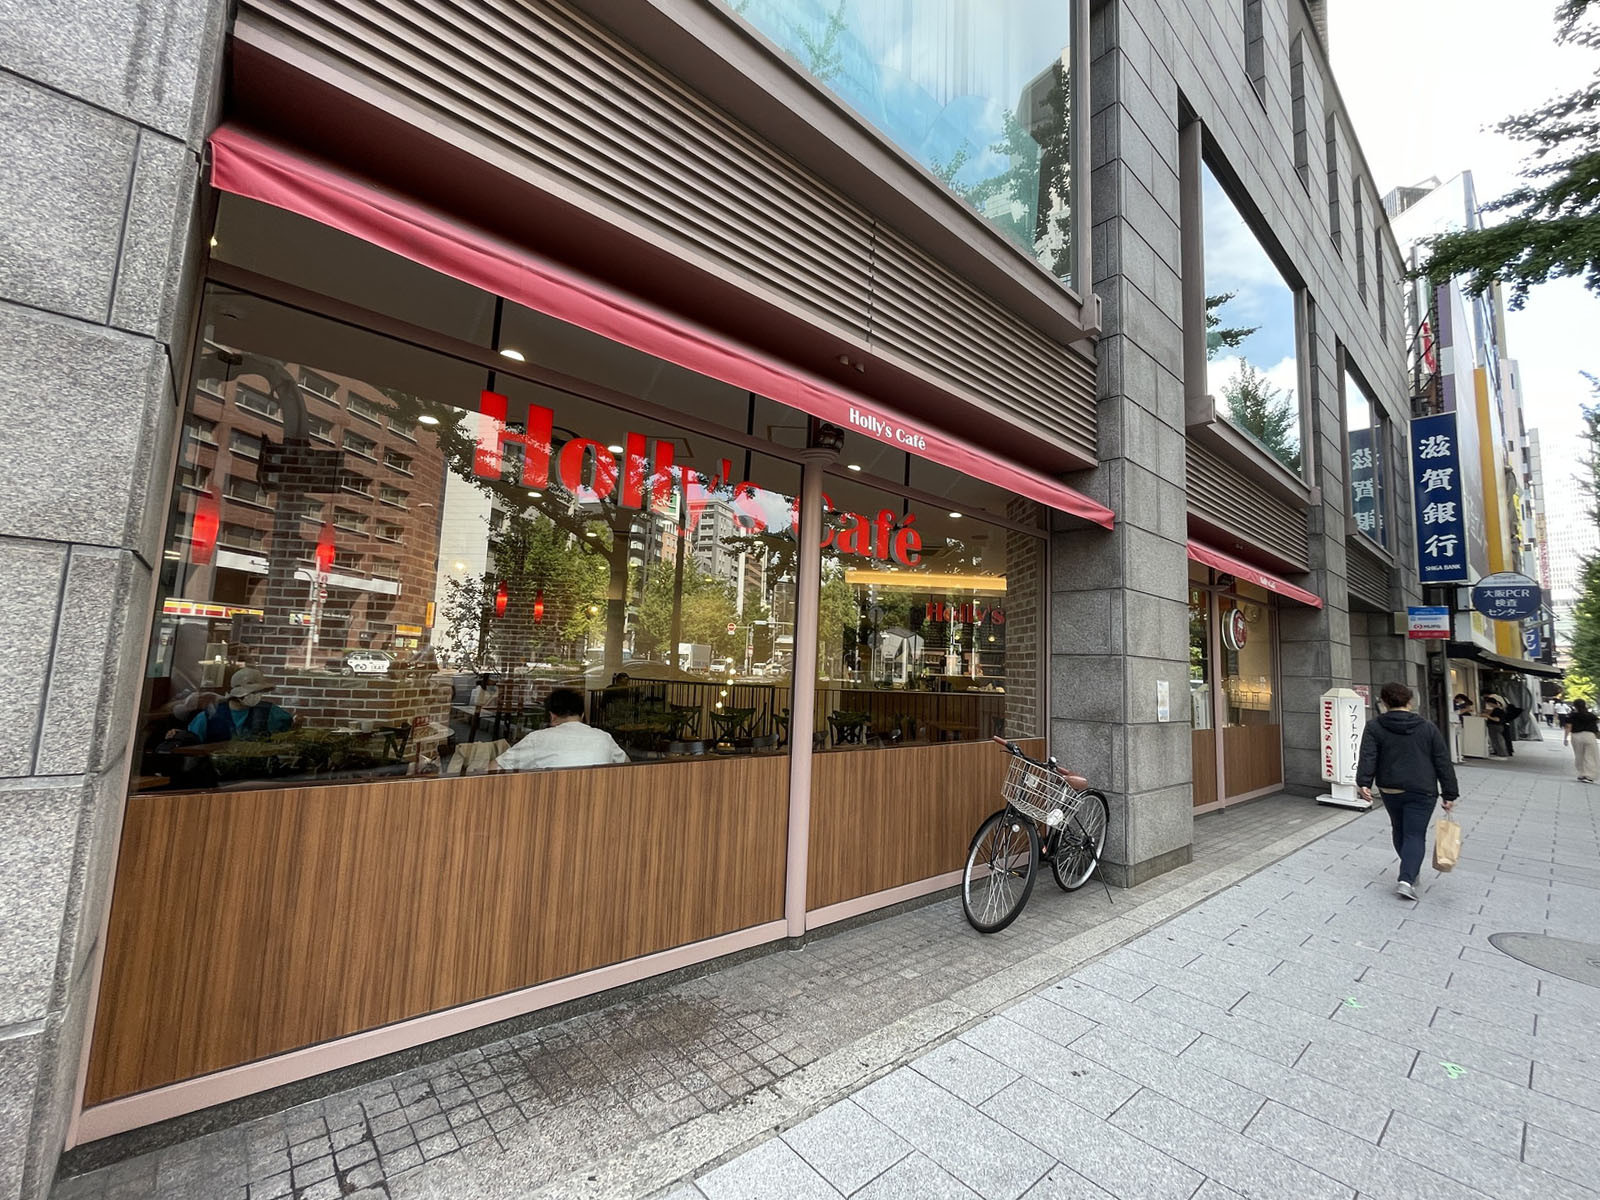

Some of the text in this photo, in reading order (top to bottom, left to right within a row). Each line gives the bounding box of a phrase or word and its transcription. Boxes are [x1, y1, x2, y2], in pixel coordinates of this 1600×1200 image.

[849, 407, 927, 451] Holly's Café
[1418, 435, 1459, 558] 滋賀銀行
[1483, 589, 1530, 598] 大阪PCR
[1487, 608, 1527, 616] センター
[1324, 701, 1333, 741] Holly's
[1349, 704, 1359, 771] ソフトクリーム
